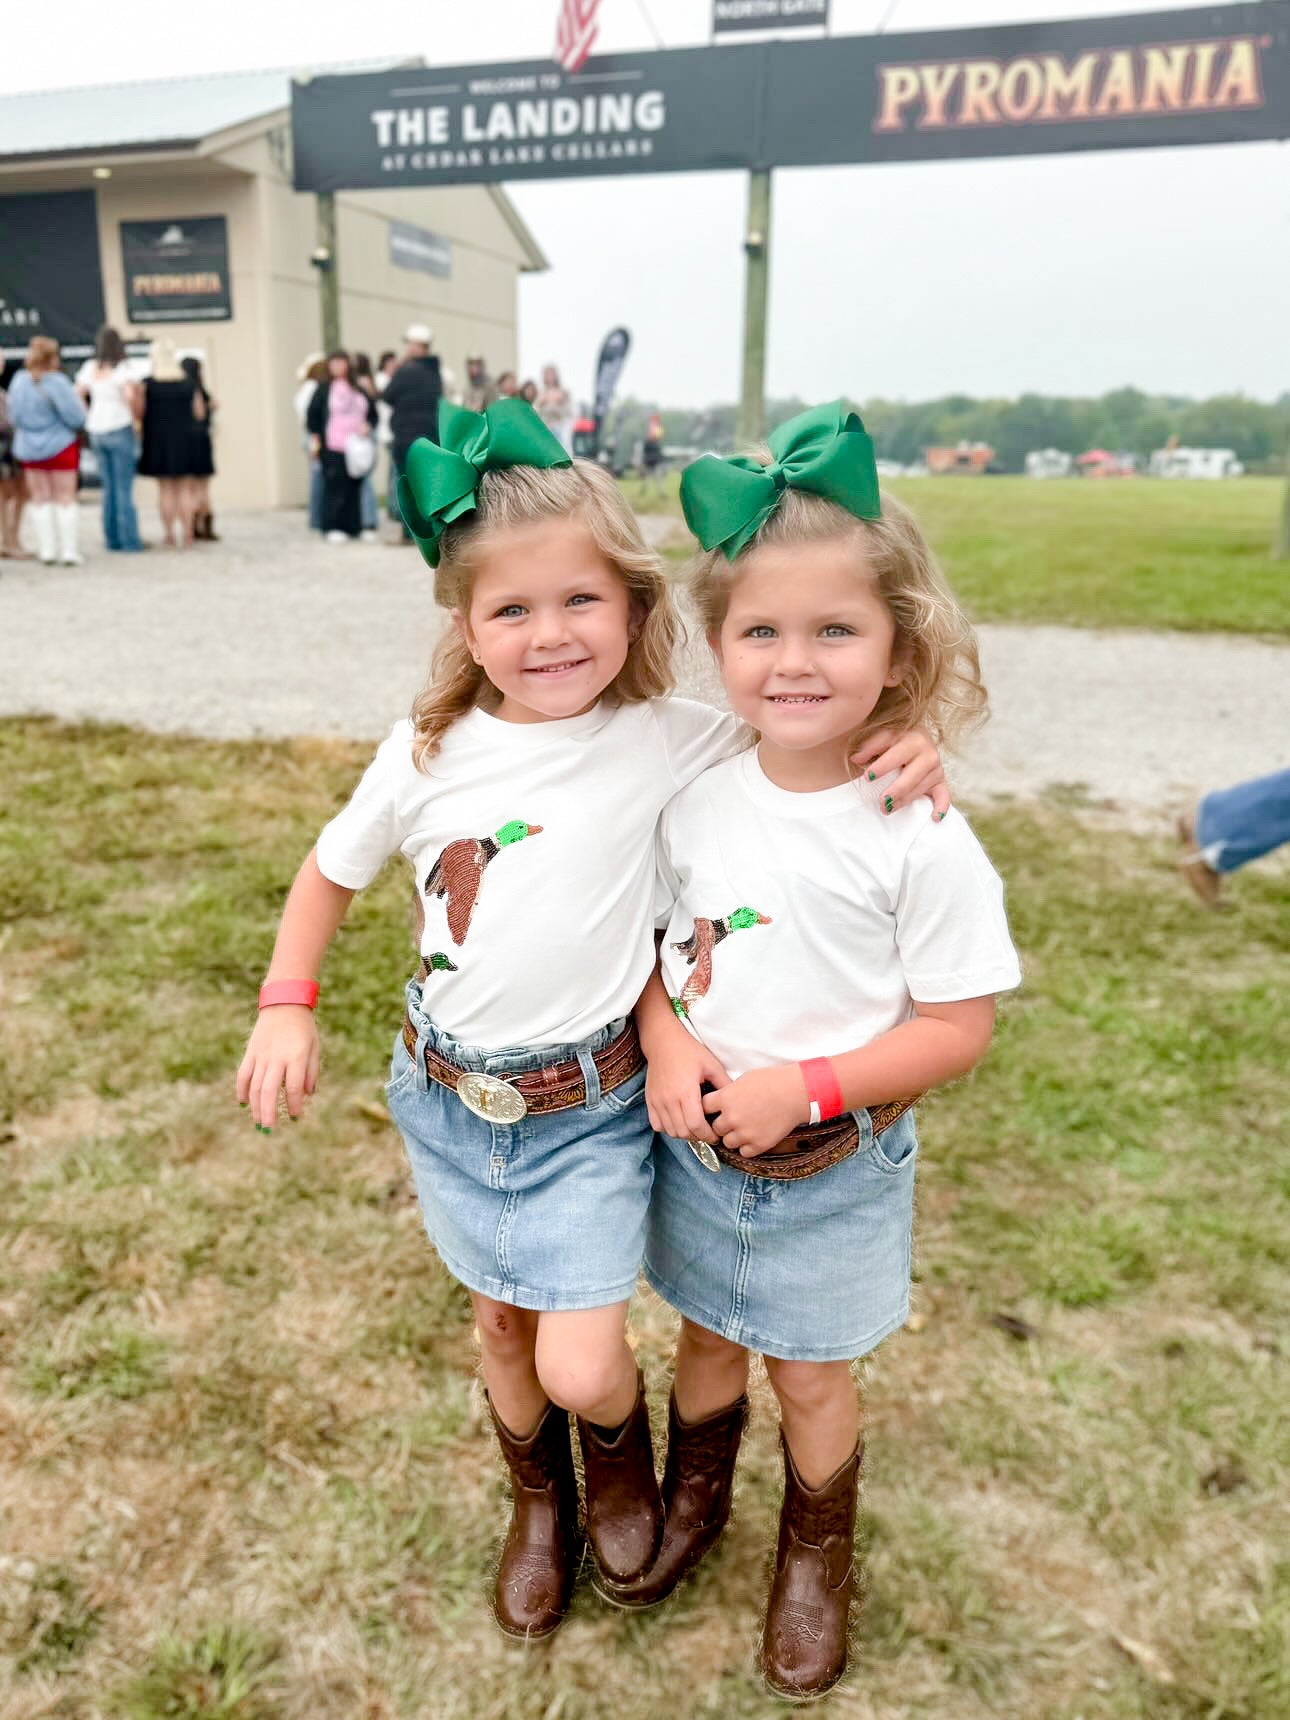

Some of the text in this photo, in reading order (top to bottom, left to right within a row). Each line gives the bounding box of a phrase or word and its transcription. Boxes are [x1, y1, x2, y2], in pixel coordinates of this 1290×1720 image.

[718, 0, 776, 19] NORTH
[469, 73, 560, 96] WELCOME TO
[874, 39, 1263, 132] PYROMANIA
[370, 90, 666, 147] THE LANDING
[381, 137, 654, 171] AT CEDAR LAKE CELLARS
